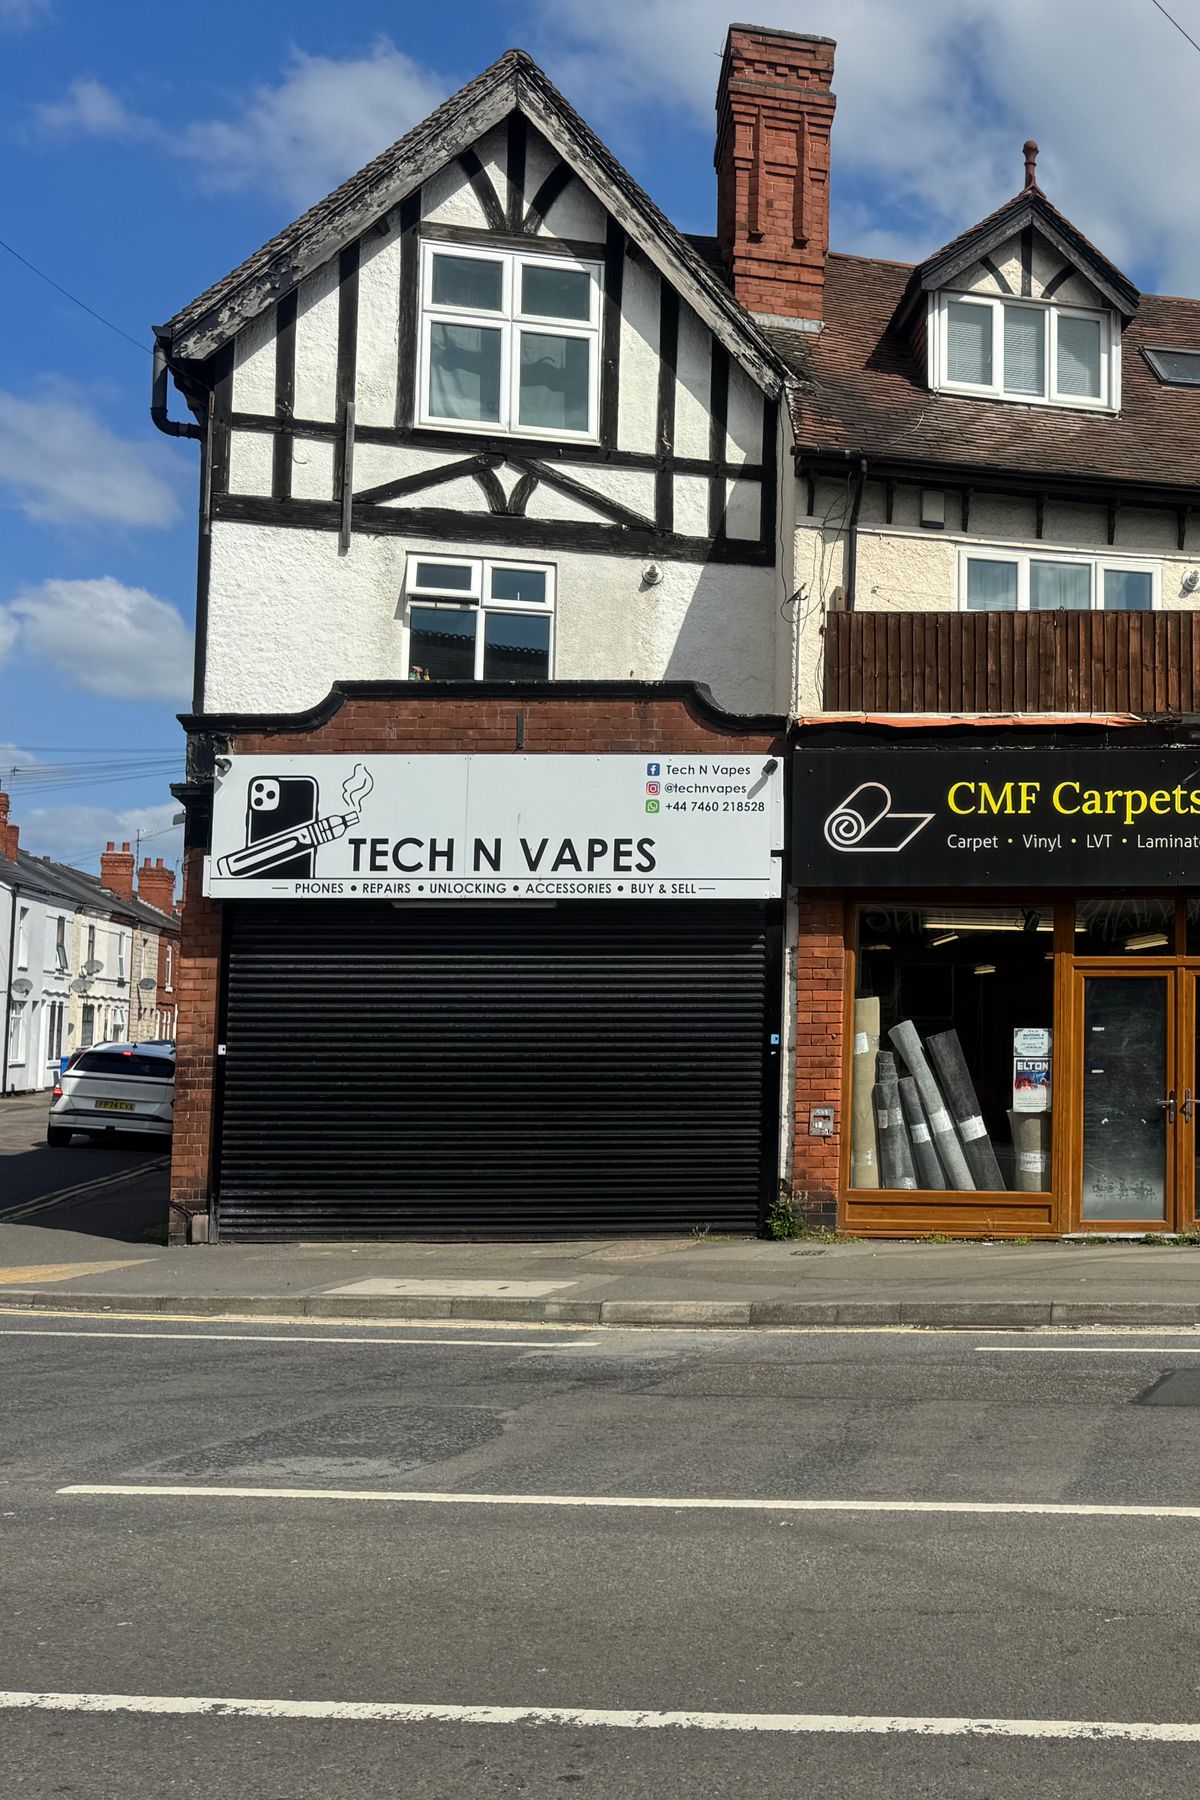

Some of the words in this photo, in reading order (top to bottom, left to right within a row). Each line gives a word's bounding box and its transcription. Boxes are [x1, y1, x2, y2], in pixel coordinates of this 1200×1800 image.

[666, 764, 695, 775] Tech
[700, 764, 708, 775] N
[712, 764, 751, 778] Vapes
[665, 783, 748, 797] @technvapes
[948, 782, 1040, 814] CMF
[666, 802, 686, 811] +44
[692, 802, 718, 811] 7460
[723, 802, 764, 811] 218528
[948, 835, 998, 852] Carpet
[1023, 834, 1061, 852] Vinyl
[1087, 835, 1112, 847] LVT
[349, 838, 454, 872] TECH
[474, 838, 501, 871] N
[520, 838, 656, 872] VAPES
[296, 883, 343, 893] PHONES
[363, 883, 410, 893] REPAIRS
[430, 883, 506, 893] UNLOCKING
[526, 883, 611, 893] ACCESSORIES
[631, 884, 654, 893] BUY
[659, 884, 666, 893] &
[672, 884, 696, 893] SELL
